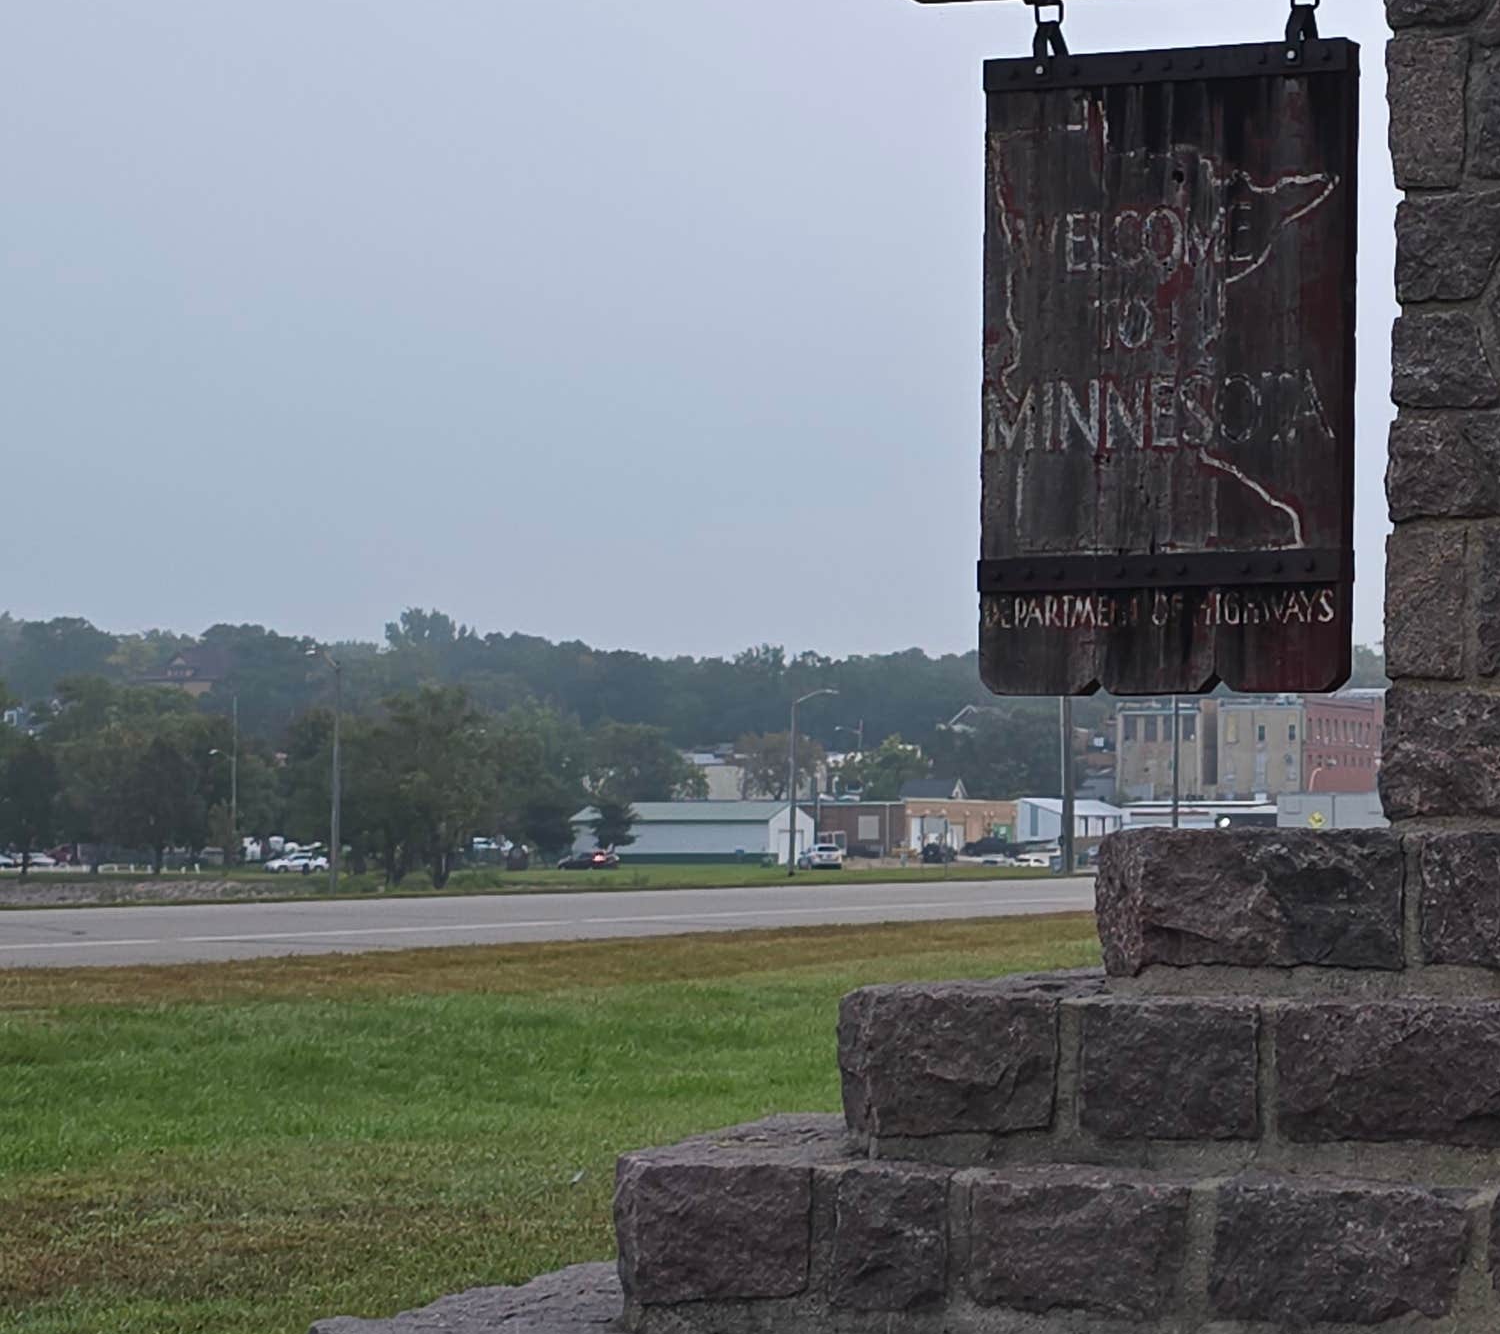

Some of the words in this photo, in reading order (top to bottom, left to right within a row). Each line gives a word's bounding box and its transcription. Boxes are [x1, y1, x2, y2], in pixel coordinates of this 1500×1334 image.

[1014, 203, 1254, 273] WELCOME
[1093, 297, 1152, 349] TO
[984, 368, 1336, 452] MINNESOTA
[1151, 592, 1183, 627] OF
